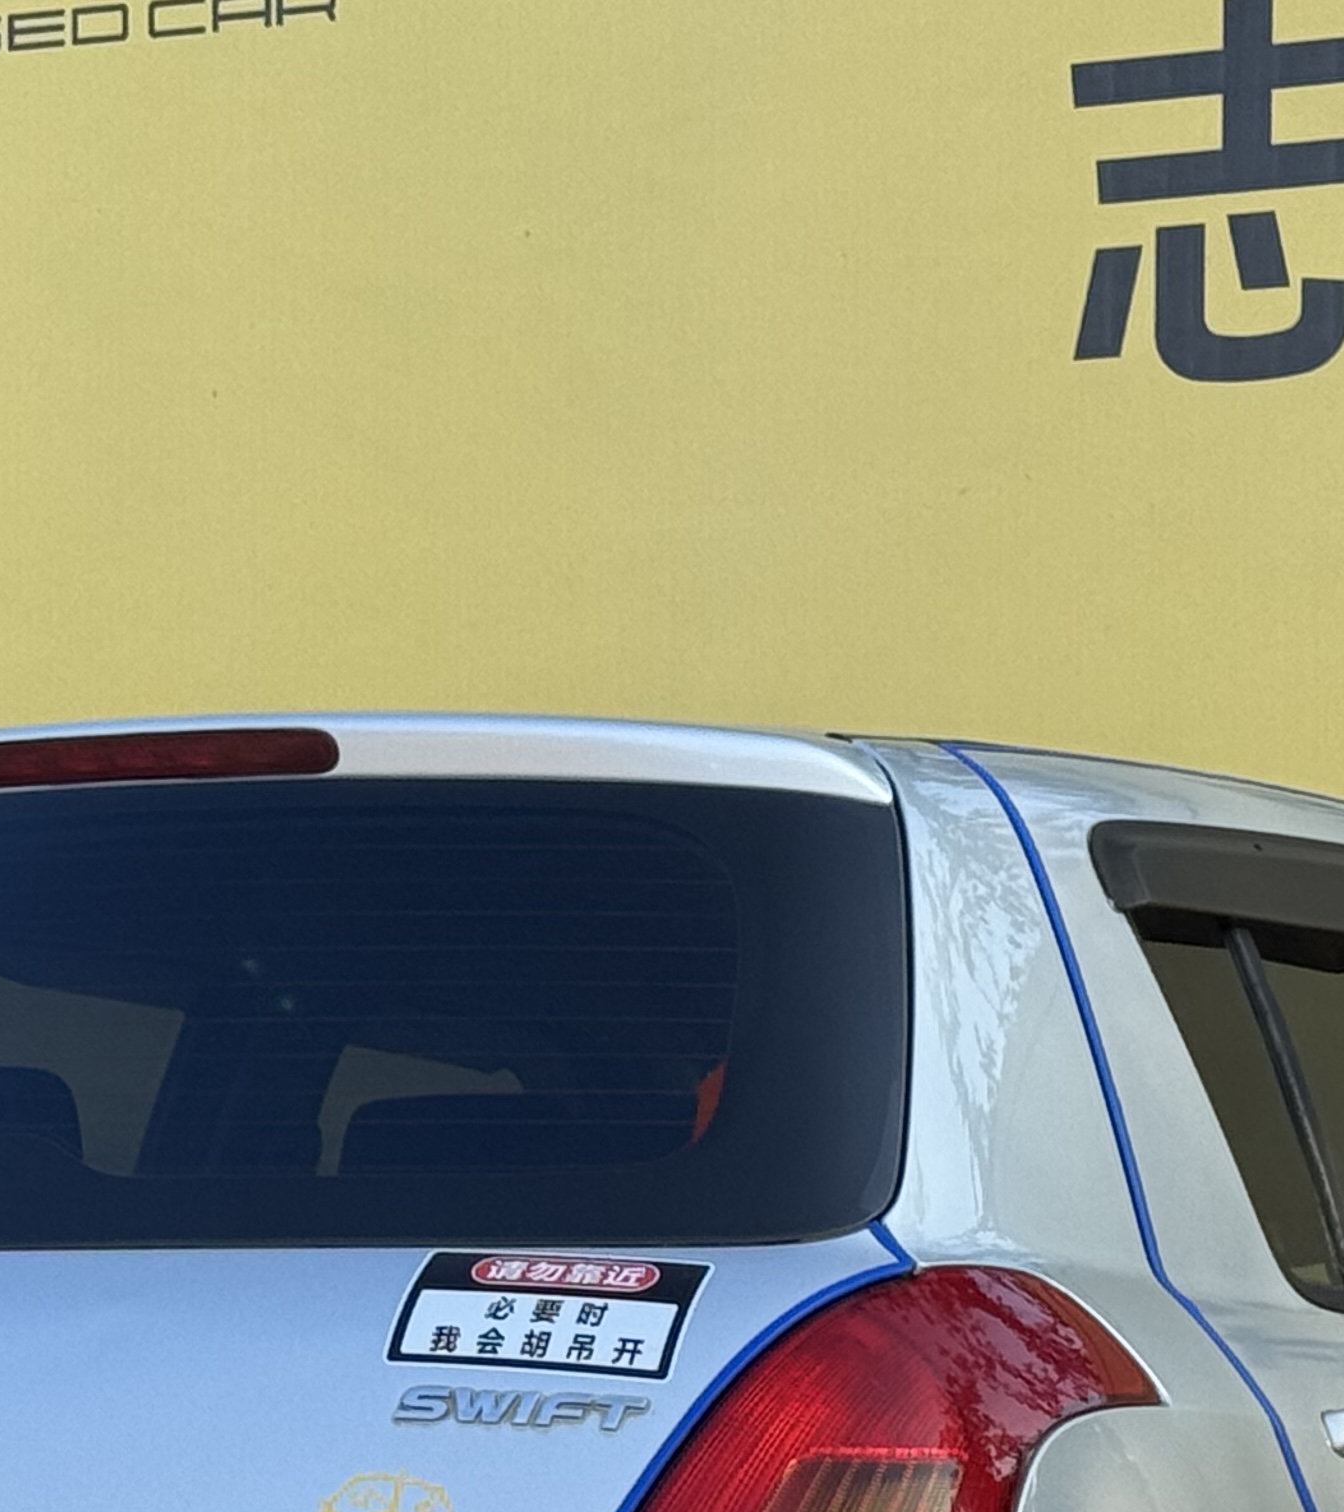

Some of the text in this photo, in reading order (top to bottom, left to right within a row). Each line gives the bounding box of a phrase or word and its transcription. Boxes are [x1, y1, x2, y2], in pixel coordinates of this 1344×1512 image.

[147, 0, 337, 39] CAR
[485, 1260, 647, 1287] 请勿靠近
[485, 1296, 608, 1327] 必要时
[429, 1325, 645, 1366] 我会胡吊开
[393, 1385, 651, 1432] SWIFT
